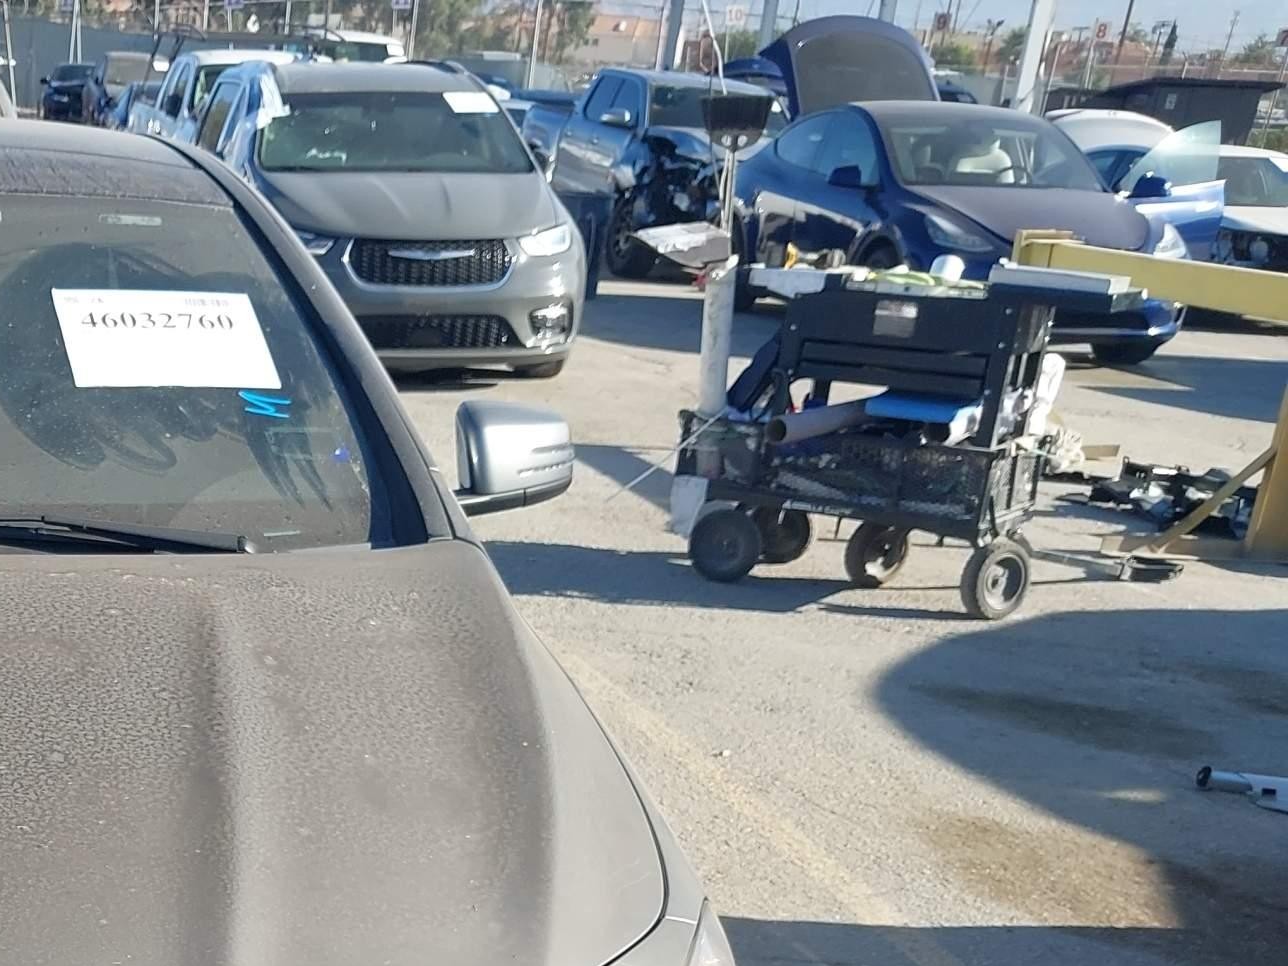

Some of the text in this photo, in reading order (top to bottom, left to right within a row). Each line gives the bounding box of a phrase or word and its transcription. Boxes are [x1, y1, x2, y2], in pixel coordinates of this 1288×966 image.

[728, 9, 743, 21] 10
[937, 13, 947, 30] 9
[1096, 23, 1108, 39] 8
[80, 311, 234, 330] 46032760
